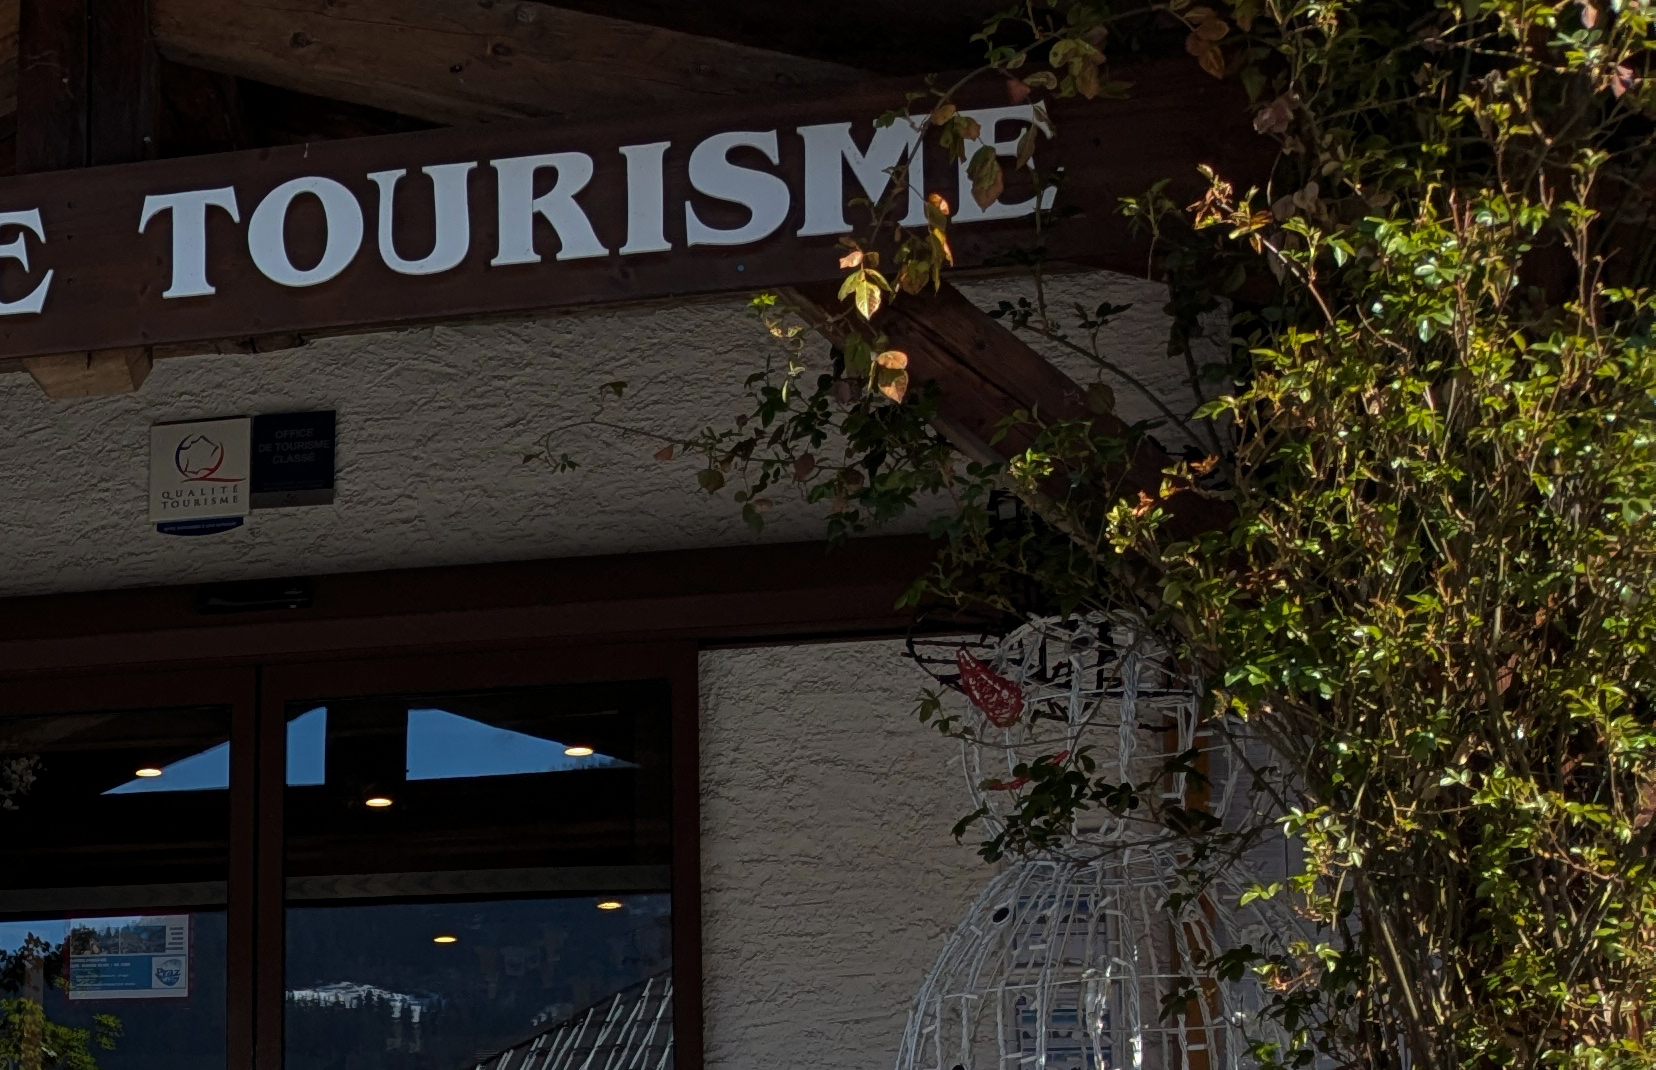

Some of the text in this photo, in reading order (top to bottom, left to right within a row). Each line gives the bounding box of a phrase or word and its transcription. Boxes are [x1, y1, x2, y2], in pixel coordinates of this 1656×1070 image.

[138, 99, 1059, 299] TOURISME
[275, 428, 314, 439] OFFICE
[258, 439, 330, 453] DE TOURISME
[272, 451, 315, 464] CLASSÉ
[161, 484, 238, 500] QUALITÉ
[161, 495, 238, 509] TOURISME
